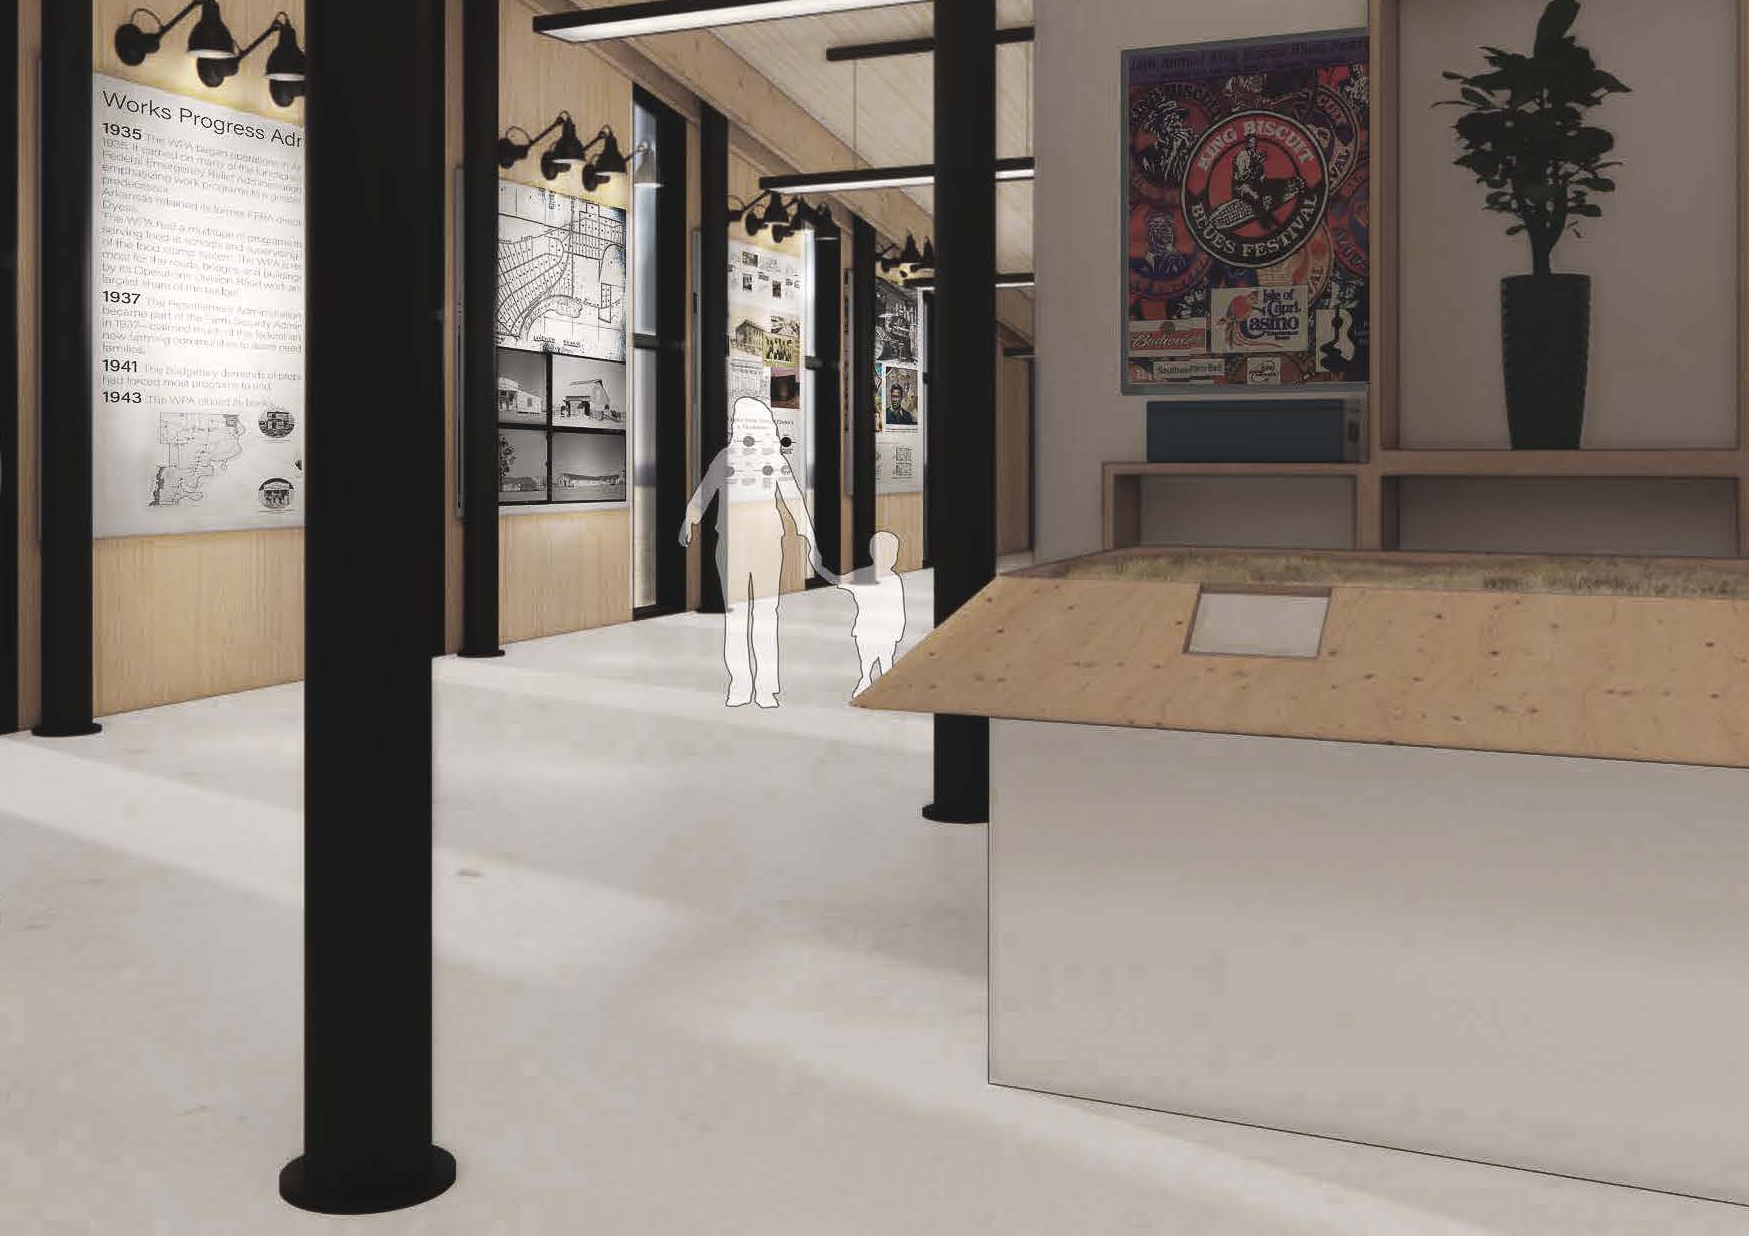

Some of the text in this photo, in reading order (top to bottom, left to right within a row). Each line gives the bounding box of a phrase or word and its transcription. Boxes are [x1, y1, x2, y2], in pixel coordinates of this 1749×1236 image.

[102, 90, 172, 120] Works
[179, 107, 265, 140] Progress
[102, 123, 142, 140] 1935
[1243, 120, 1316, 163] BISCUIT
[1191, 195, 1317, 257] BLUES FESTIVAL
[102, 290, 141, 305] 1937
[102, 358, 138, 373] 1941
[102, 391, 142, 404] 1943
